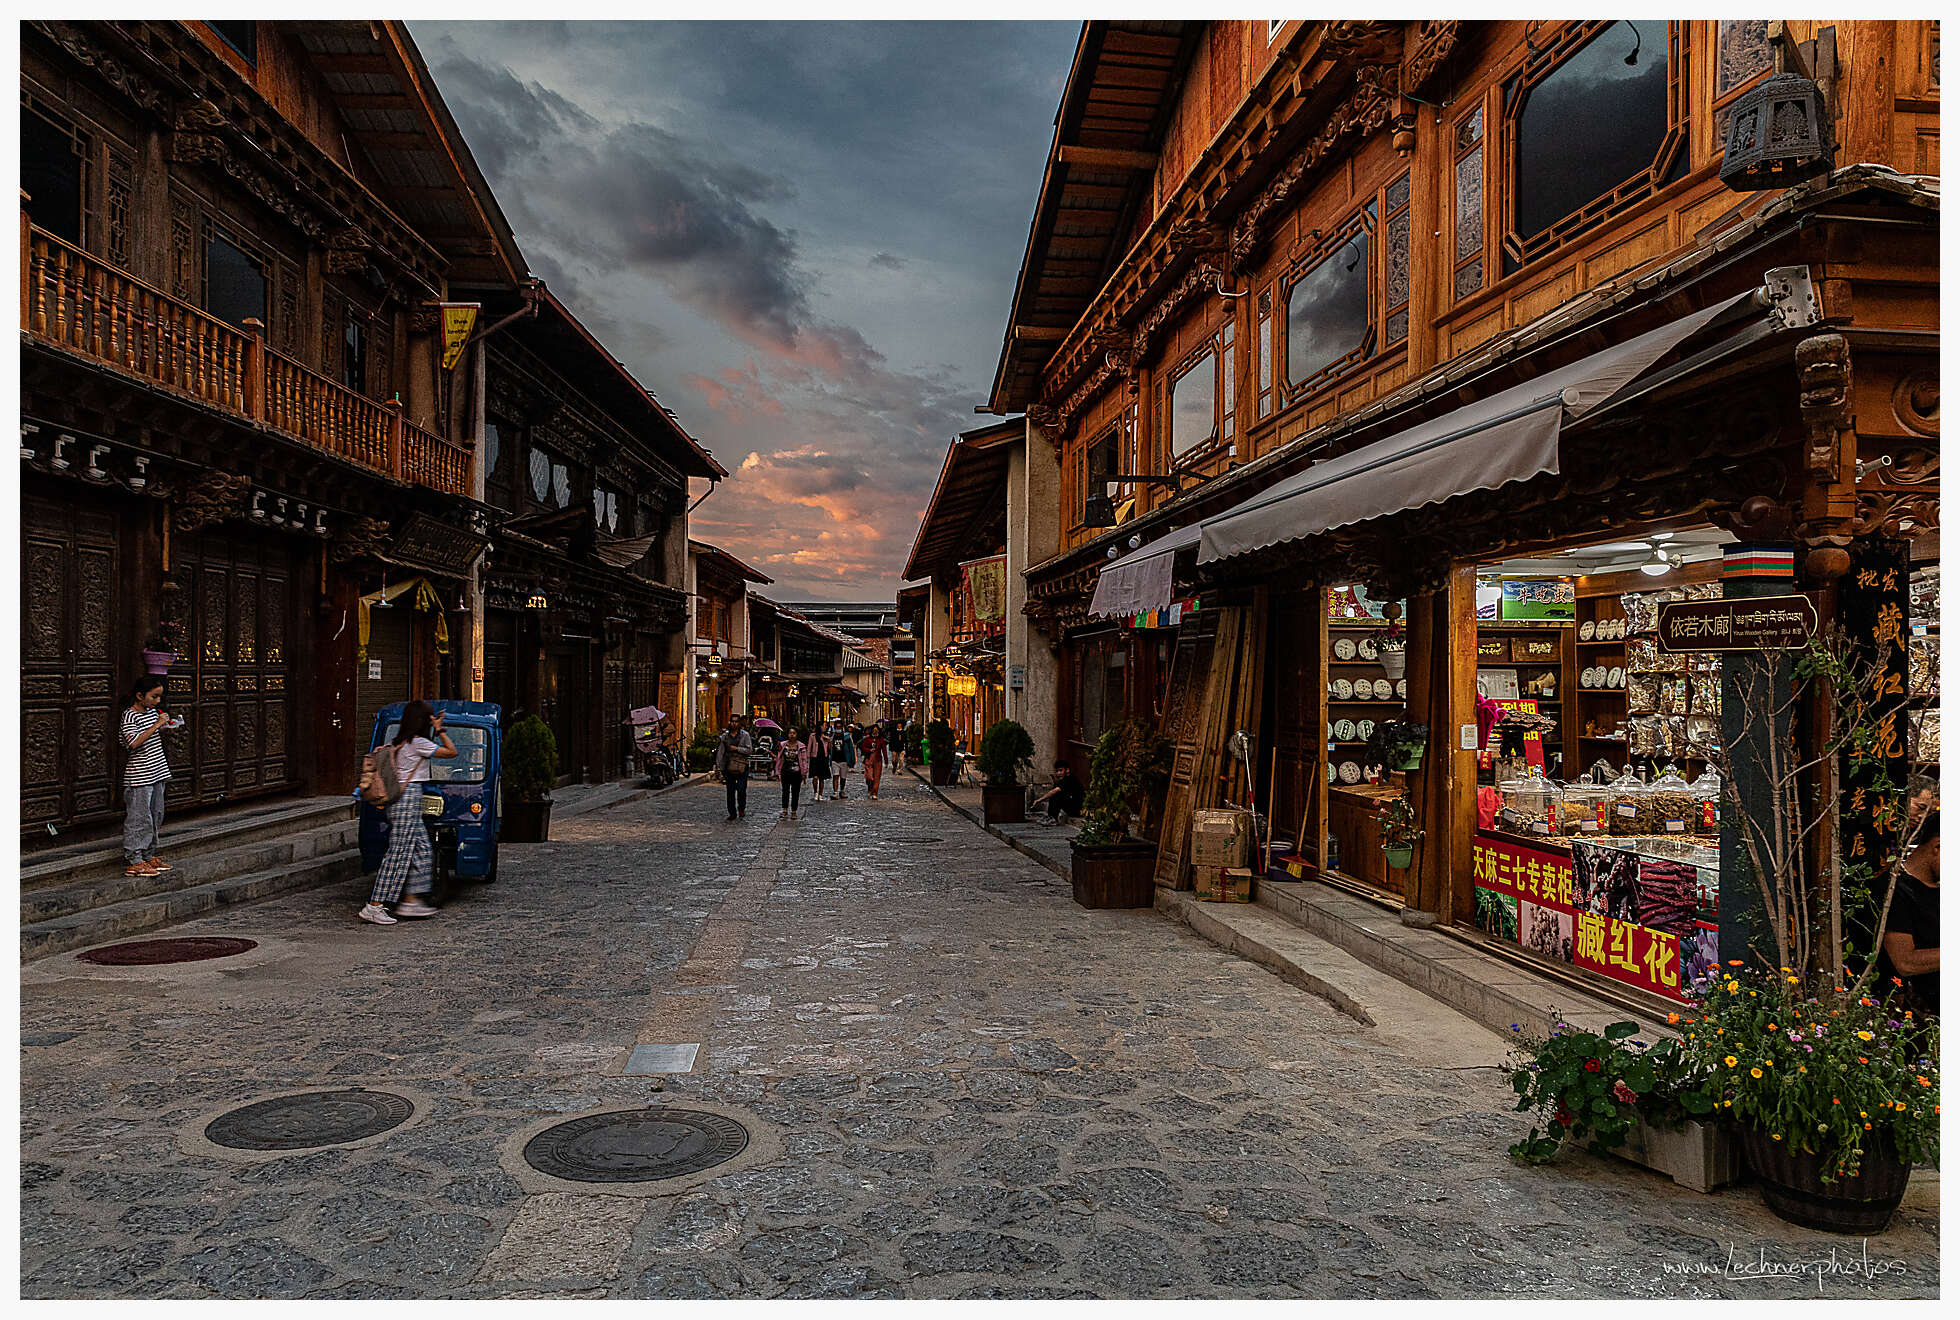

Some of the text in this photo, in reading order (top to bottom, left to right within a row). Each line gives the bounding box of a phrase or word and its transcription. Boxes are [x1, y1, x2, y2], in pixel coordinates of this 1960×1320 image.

[1516, 586, 1574, 607] 牛吃虫
[1669, 614, 1730, 638] 依若木廊
[1848, 702, 1867, 858] 年老店
[1473, 845, 1573, 906] 天麻三七专卖柜
[1577, 912, 1677, 988] 藏红花
